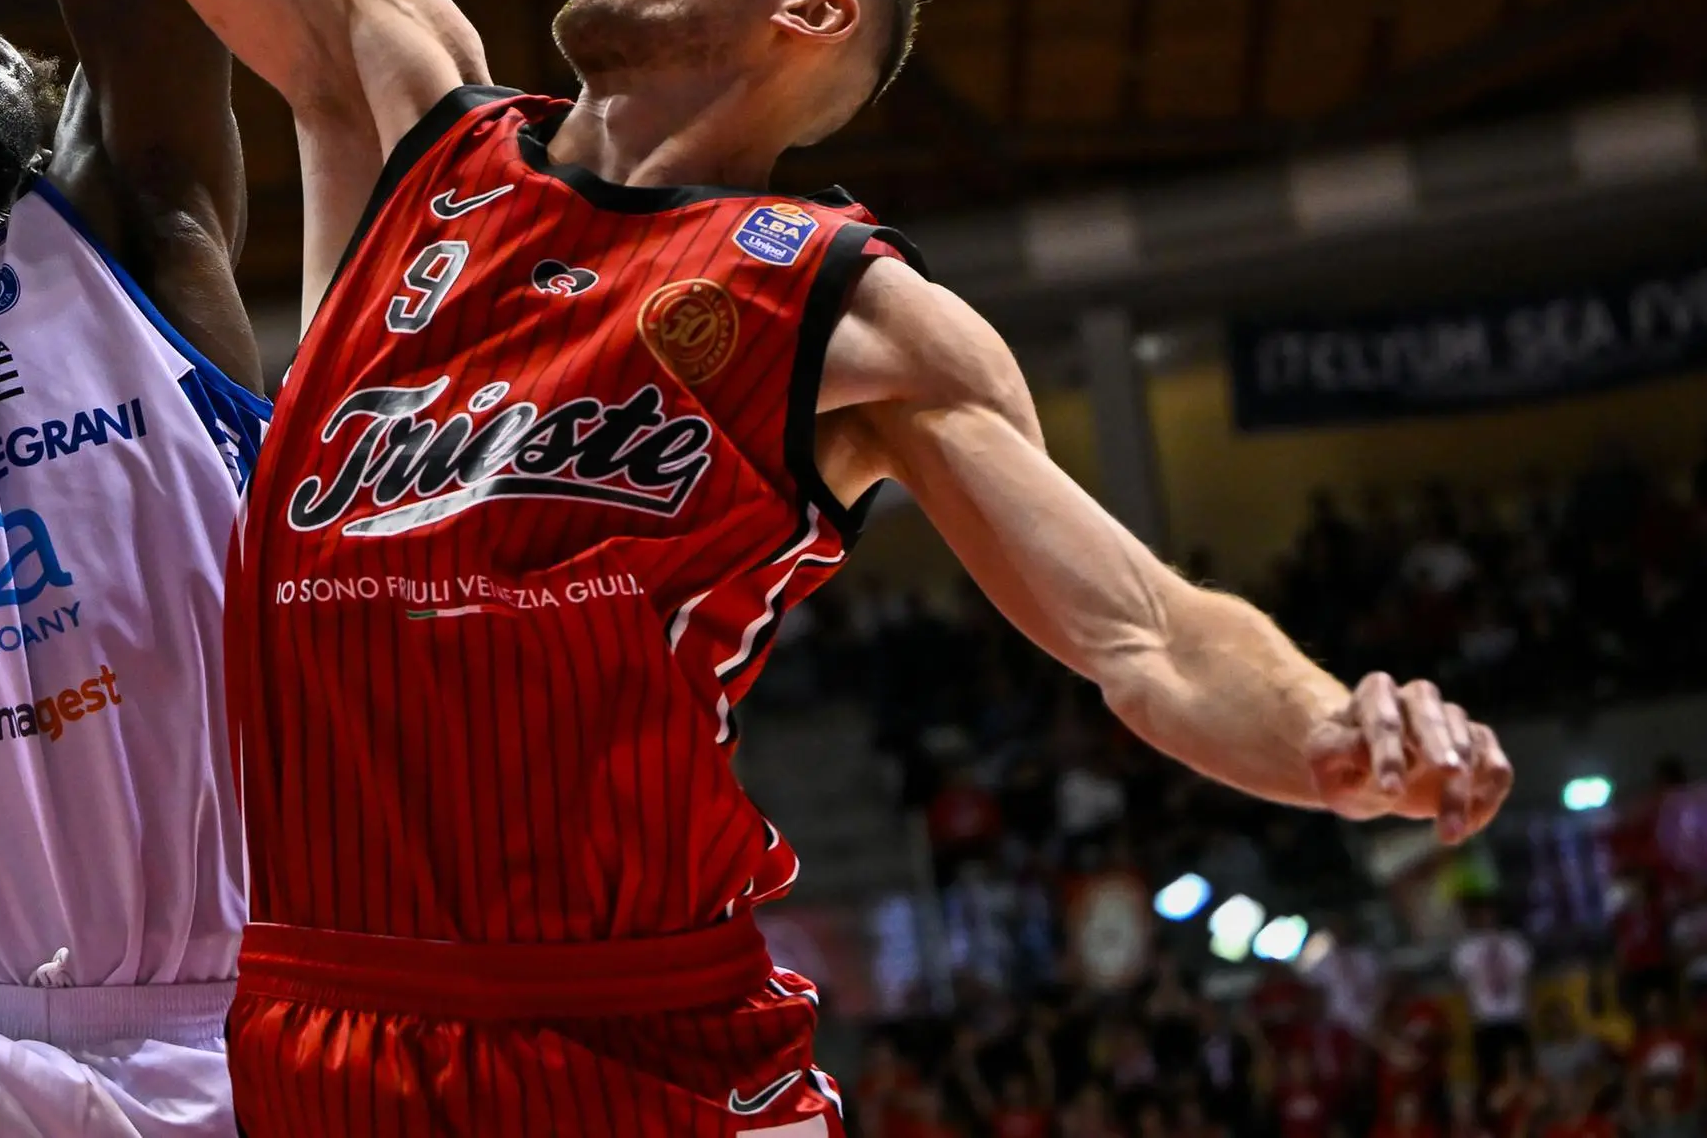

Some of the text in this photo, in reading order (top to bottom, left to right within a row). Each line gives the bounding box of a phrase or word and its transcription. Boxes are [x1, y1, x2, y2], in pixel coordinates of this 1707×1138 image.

[755, 216, 800, 241] LBA
[748, 236, 788, 259] Unipol
[386, 240, 470, 334] 9
[663, 303, 719, 348] 50
[288, 375, 712, 537] Trieste
[276, 576, 296, 604] IO
[299, 576, 379, 603] SONO
[385, 576, 450, 603] FRIULI
